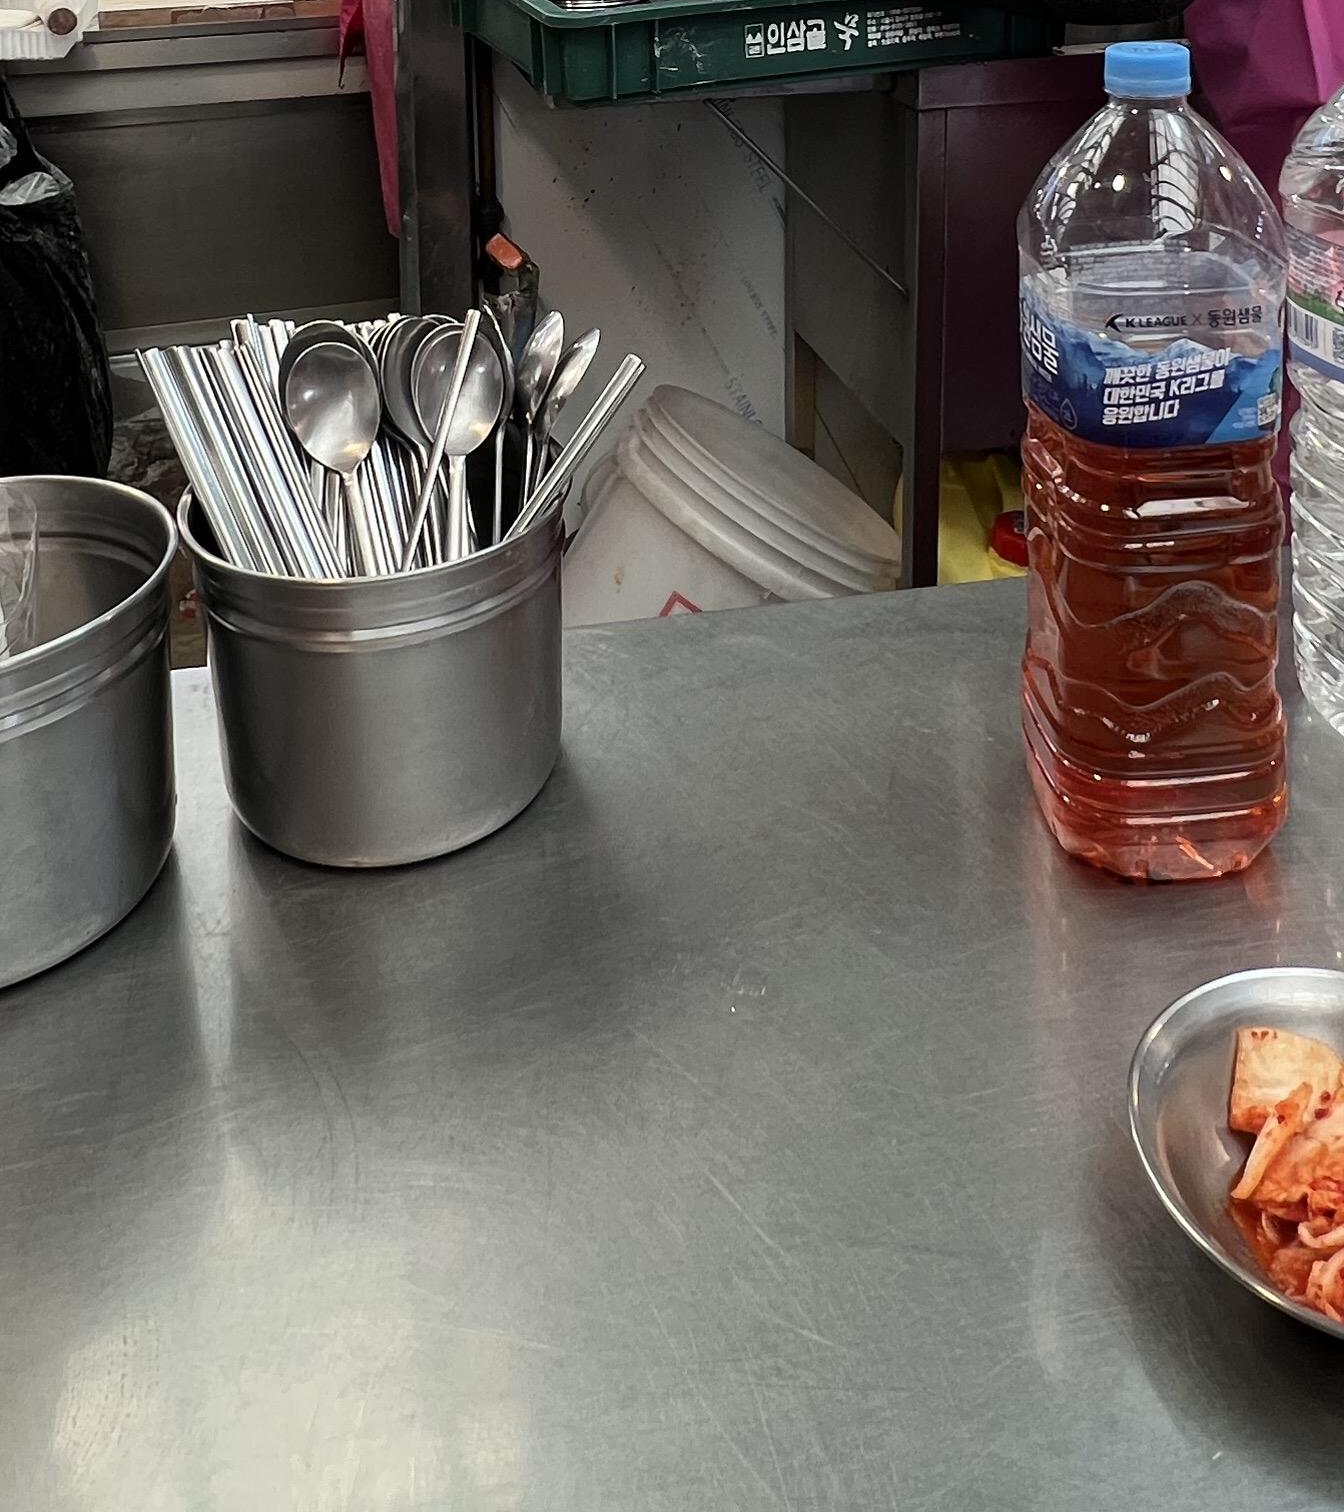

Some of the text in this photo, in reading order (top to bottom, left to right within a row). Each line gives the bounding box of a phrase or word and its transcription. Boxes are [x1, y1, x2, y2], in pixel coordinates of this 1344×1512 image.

[1208, 306, 1263, 329] 동원샘물
[1103, 381, 1167, 405] 대한민국
[1102, 398, 1181, 426] 응원합니다
